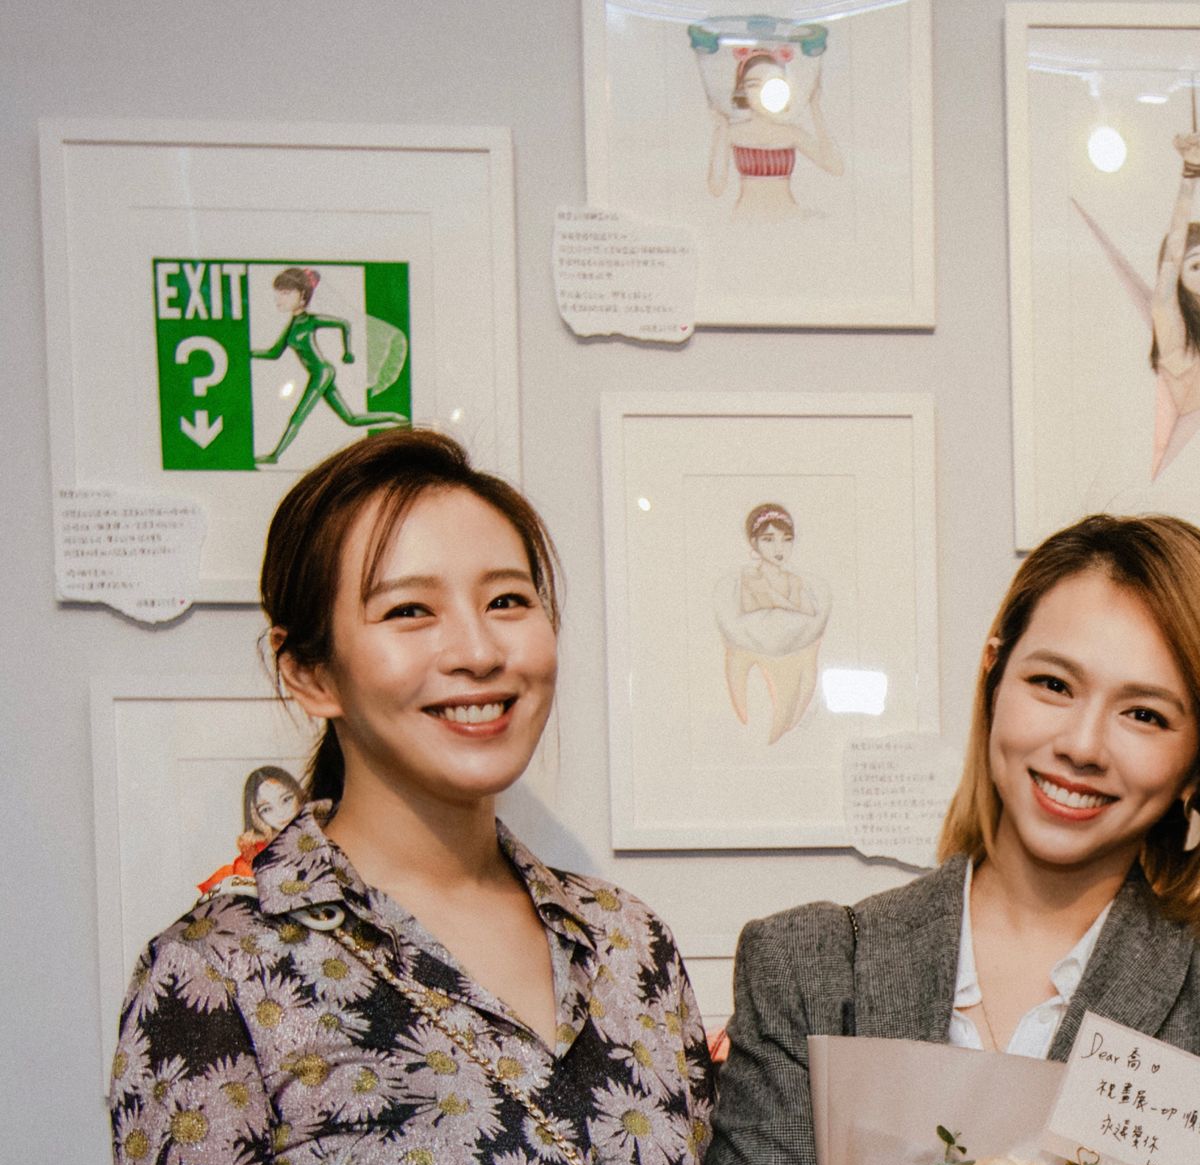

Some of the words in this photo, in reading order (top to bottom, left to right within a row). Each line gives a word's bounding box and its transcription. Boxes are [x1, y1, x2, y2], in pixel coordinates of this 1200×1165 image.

[156, 263, 247, 320] EXIT
[175, 335, 228, 397] ?
[1081, 1032, 1120, 1065] Dear
[1101, 1113, 1159, 1154] 永遠愛你
